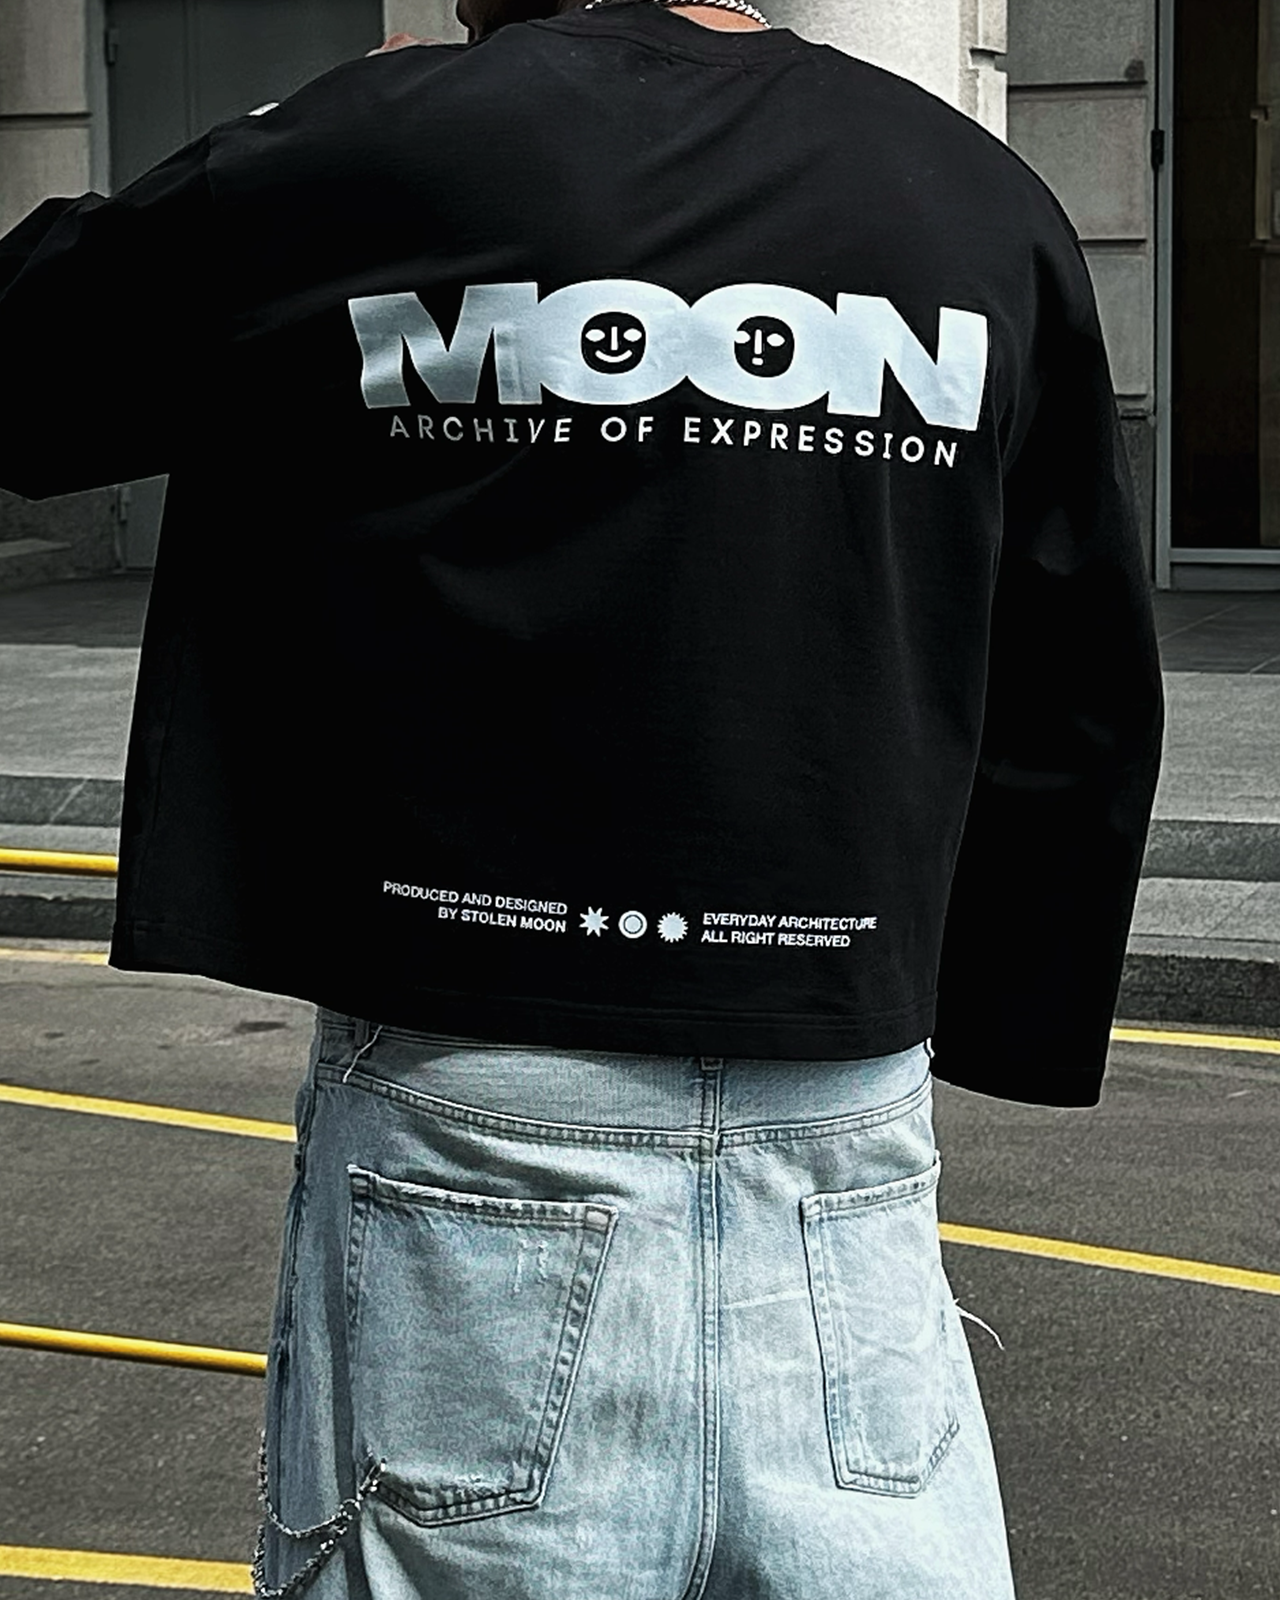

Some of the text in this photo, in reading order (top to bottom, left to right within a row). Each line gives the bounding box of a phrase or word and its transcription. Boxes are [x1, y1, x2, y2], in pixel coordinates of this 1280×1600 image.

[347, 278, 988, 431] MOON
[389, 413, 959, 468] ARCHIVE OF EXPRESSION
[383, 880, 567, 916] PRODUCED AND DESIGNED
[438, 906, 567, 933] BY STOLEN MOON
[702, 912, 878, 931] EVERYDAY ARCHITECTURE
[701, 930, 851, 948] ALL RIGHT RESERVED
